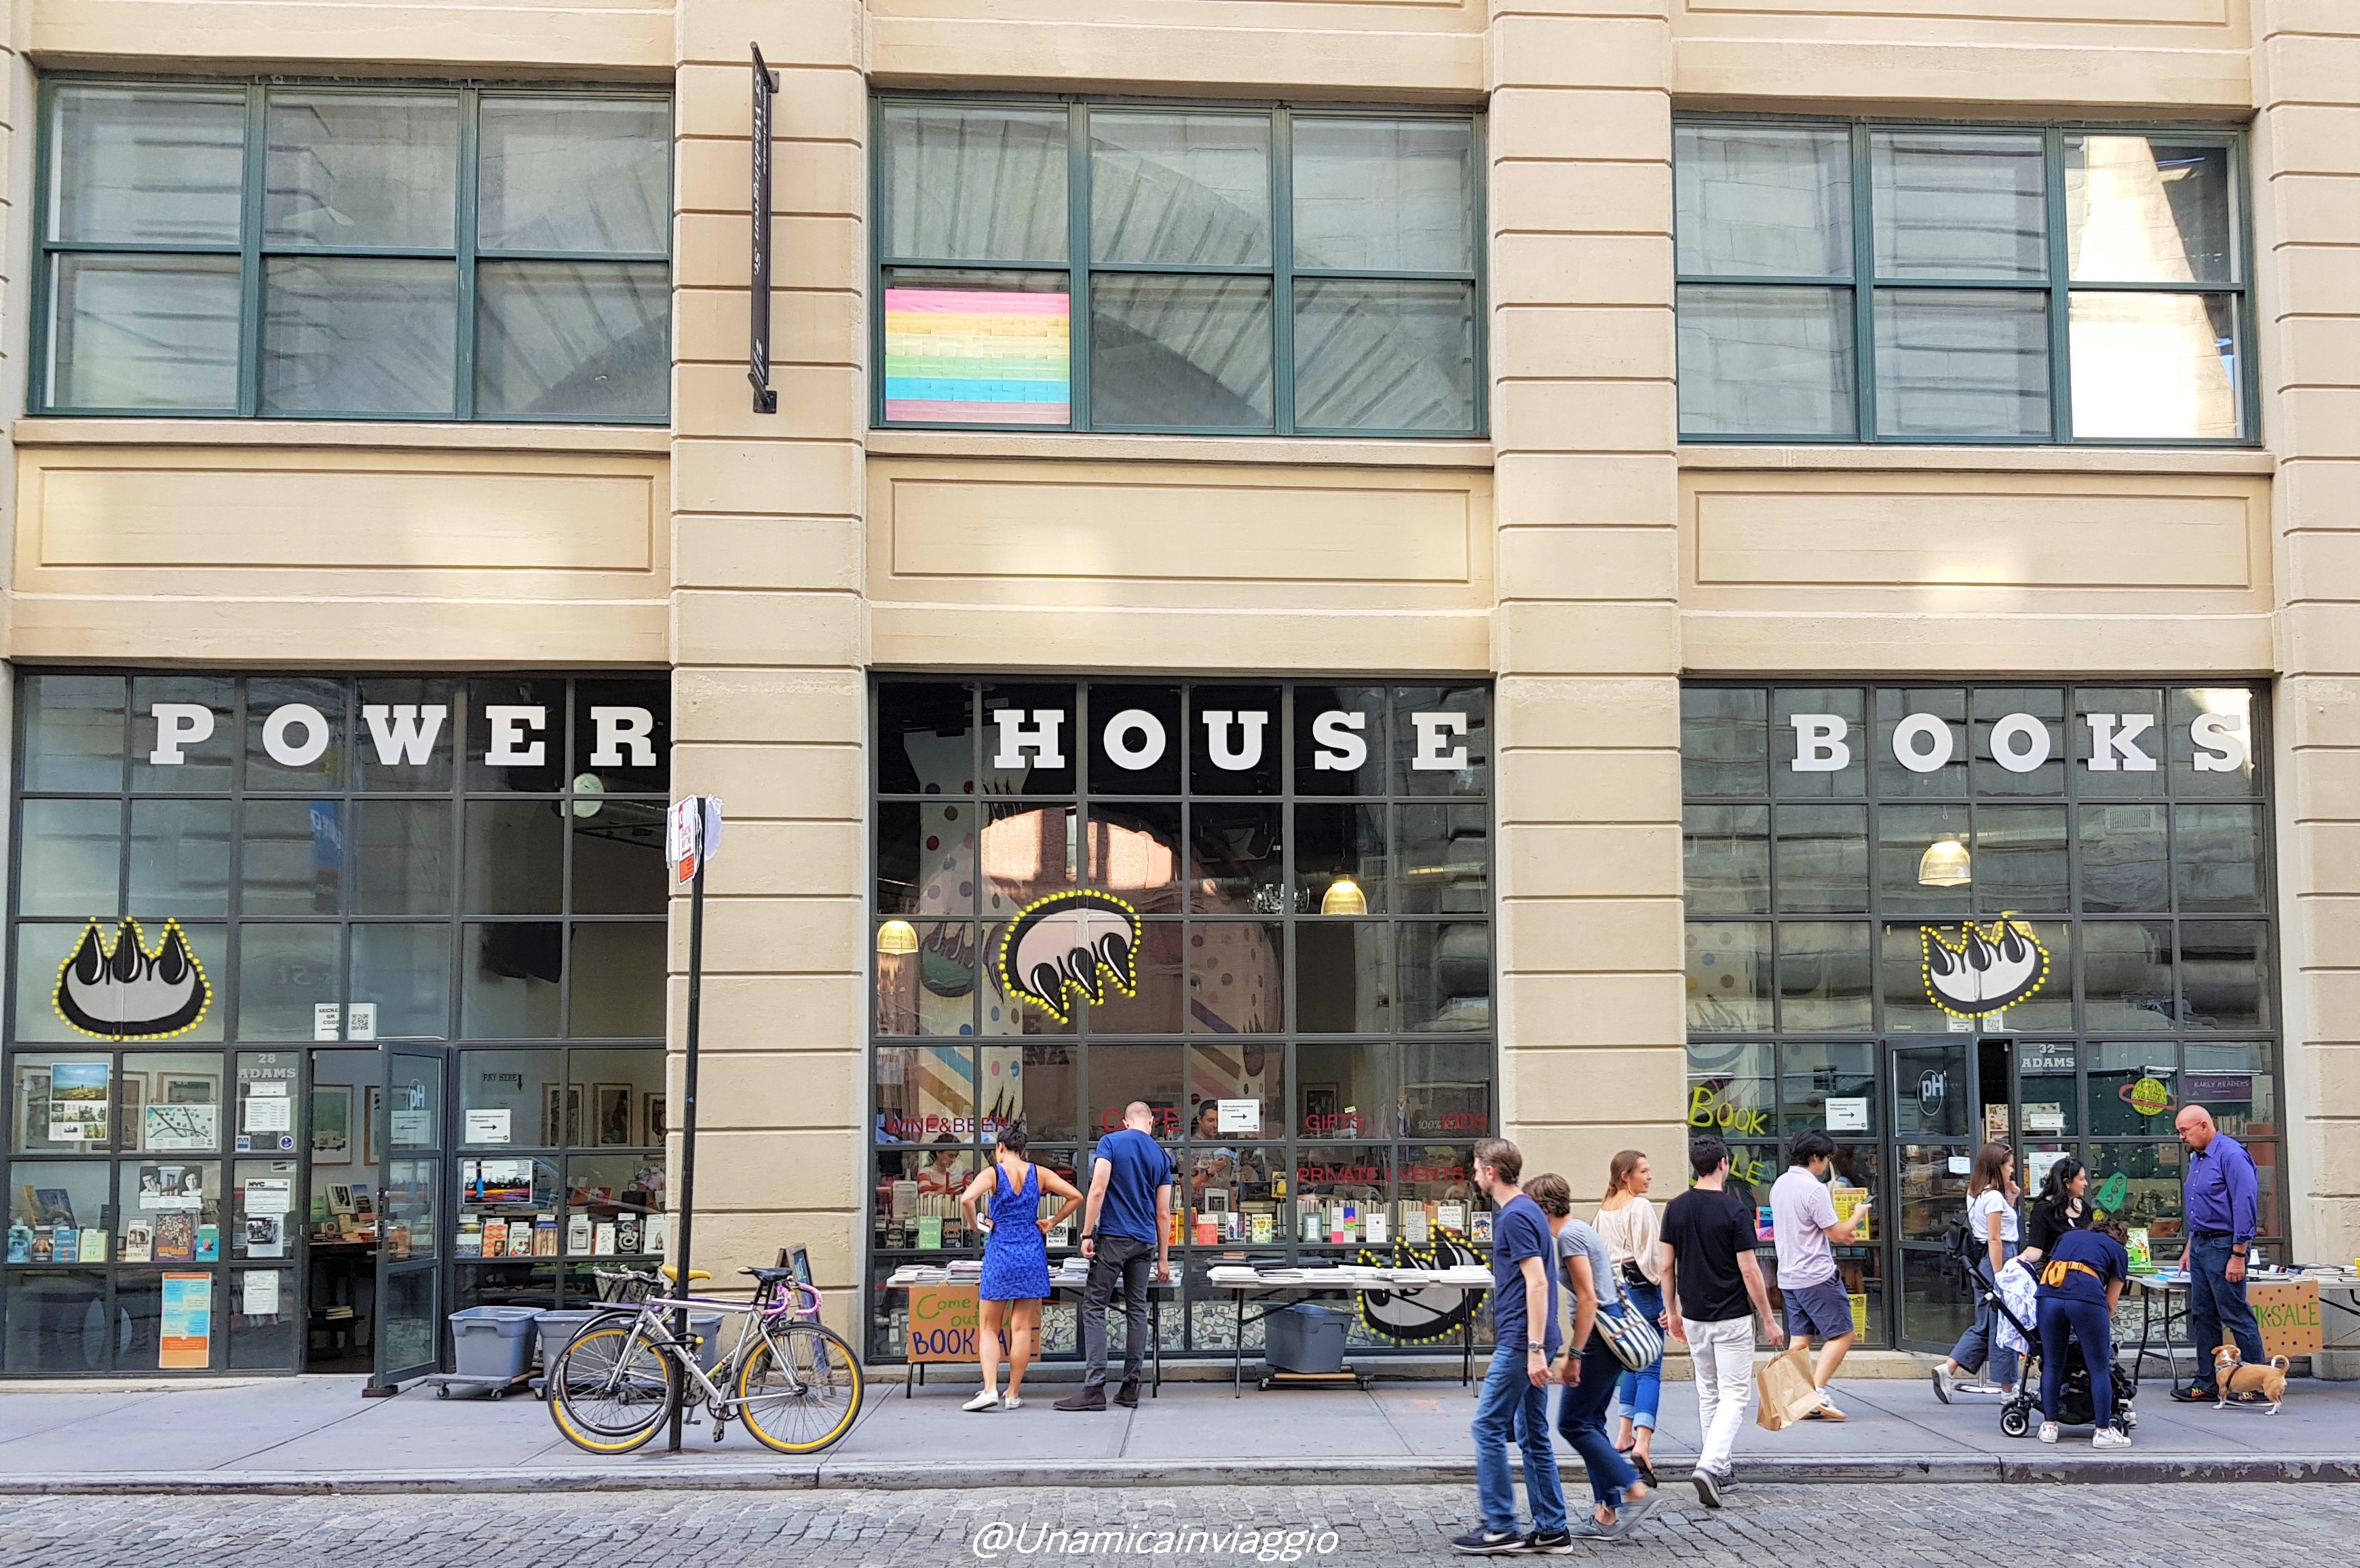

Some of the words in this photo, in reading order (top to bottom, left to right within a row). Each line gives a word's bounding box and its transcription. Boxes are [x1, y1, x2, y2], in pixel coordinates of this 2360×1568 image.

[753, 106, 761, 240] Washington
[149, 703, 657, 767] POWER
[993, 709, 1468, 771] HOUSE
[1790, 712, 2245, 773] BOOKS
[258, 1053, 276, 1064] 28
[2038, 1044, 2055, 1054] 32
[2021, 1057, 2075, 1068] ADAMS
[237, 1068, 297, 1079] ADAMS
[1922, 1074, 1945, 1102] pH
[1102, 1107, 1183, 1132] CE
[1688, 1086, 1768, 1135] BOOK
[1305, 1113, 1365, 1130] GIFTS
[1441, 1113, 1488, 1130] KIDS
[1297, 1167, 1379, 1184] PRIVATE
[916, 1293, 971, 1320] Come
[912, 1328, 977, 1356] BOOK
